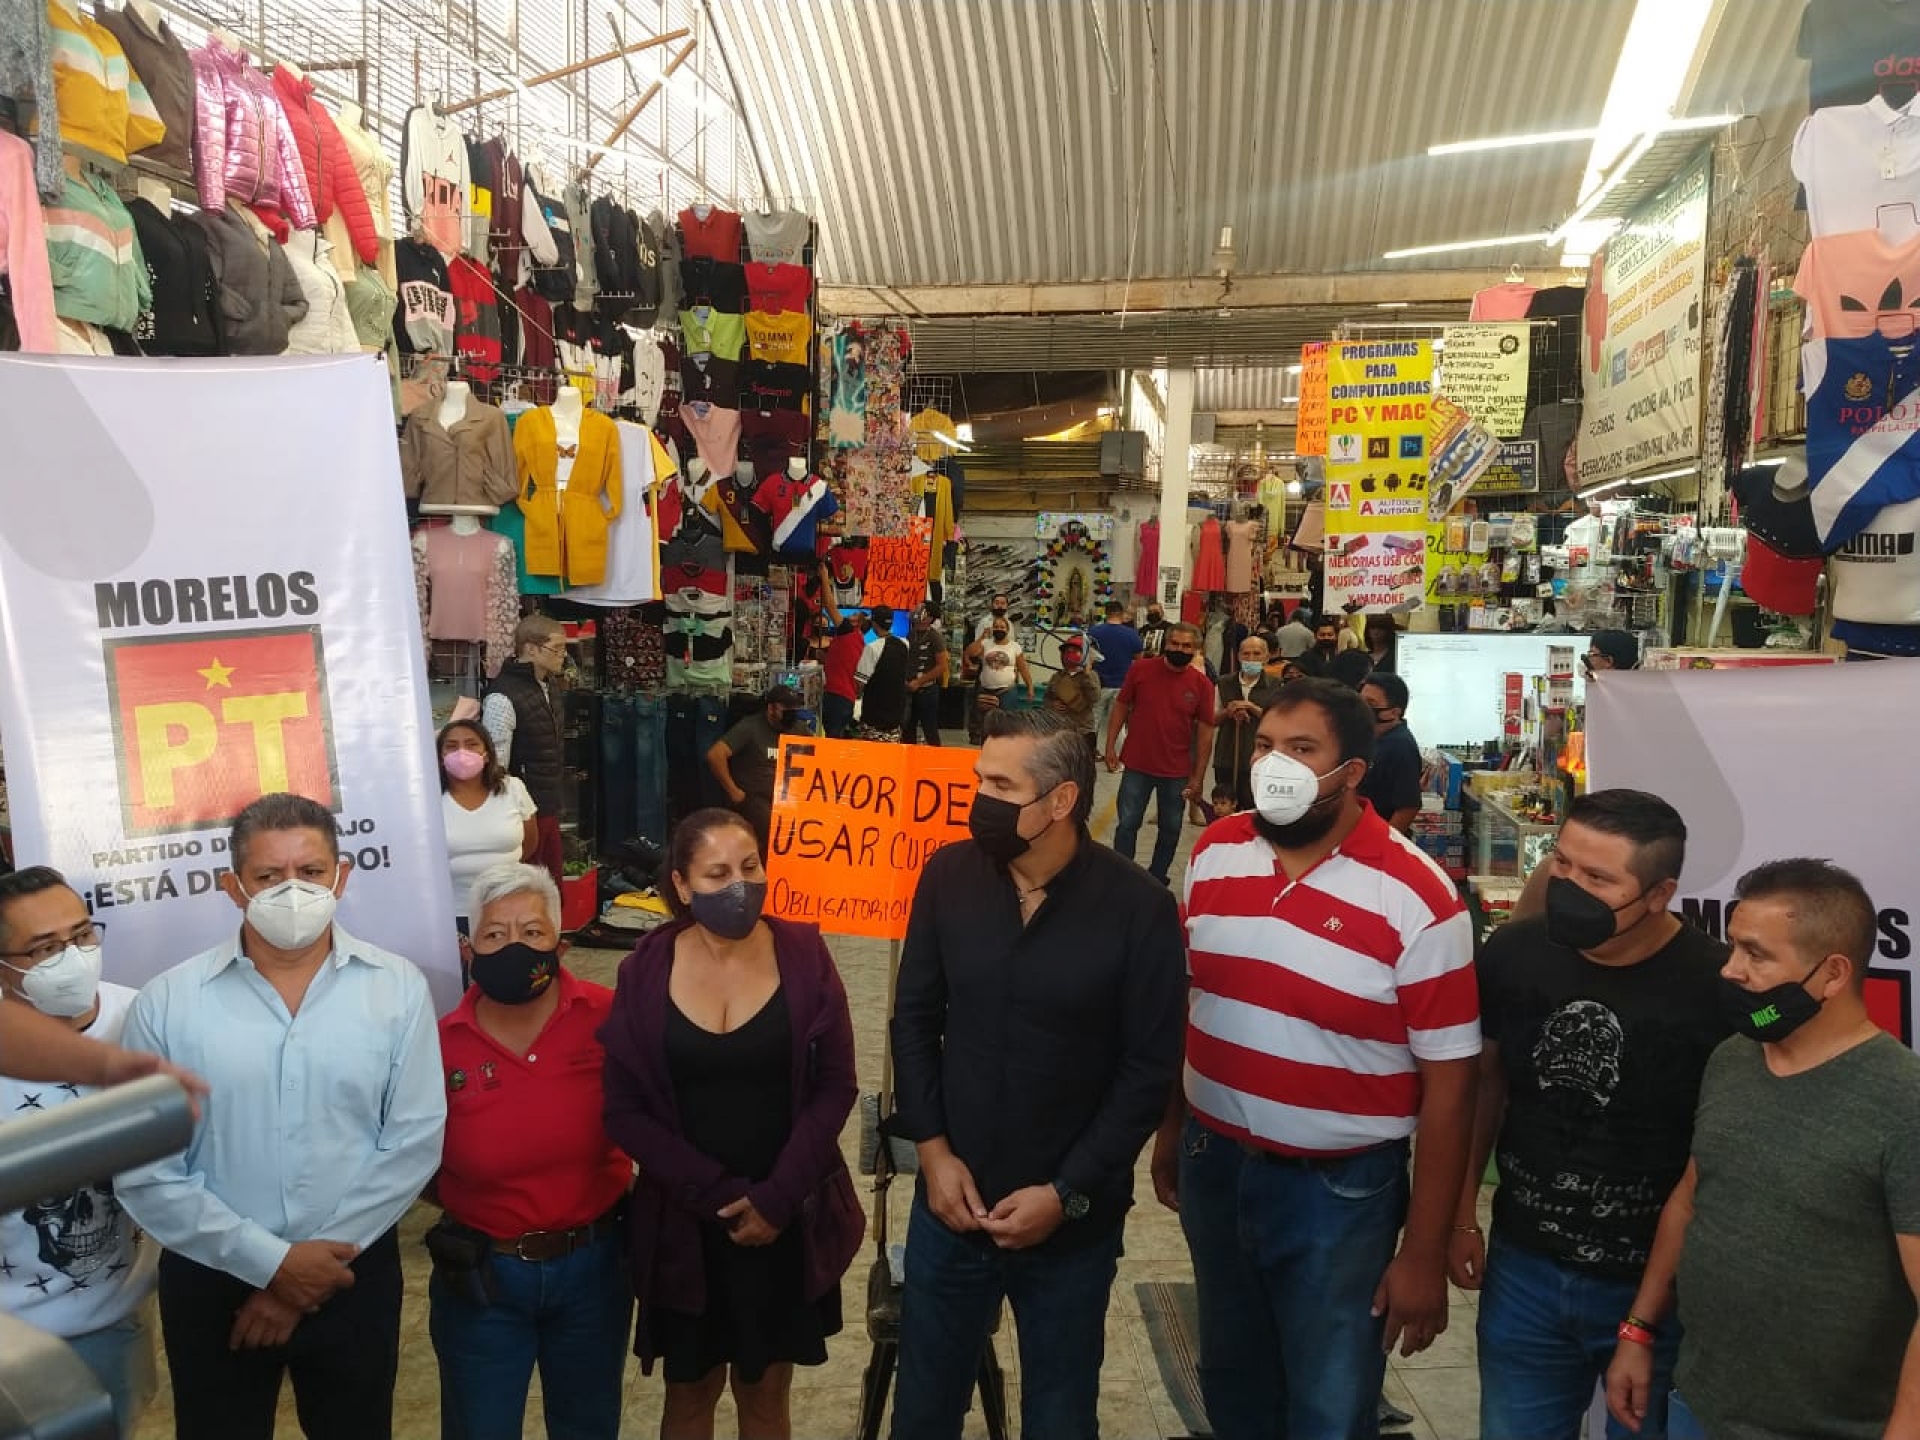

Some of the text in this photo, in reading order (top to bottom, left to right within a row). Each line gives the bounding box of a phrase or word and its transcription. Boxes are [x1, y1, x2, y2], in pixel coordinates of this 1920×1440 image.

[754, 331, 793, 342] TOMMY
[1341, 342, 1418, 360] PROGRAMAS
[1365, 363, 1397, 378] PARA
[1331, 381, 1430, 399] COMPUTADORAS
[1331, 403, 1426, 424] PC Y MAC
[1839, 405, 1907, 425] POLO
[1329, 554, 1424, 568] MEMORIAS USB CON
[94, 571, 319, 628] MORELOS
[1357, 593, 1405, 604] KARAOKE
[134, 691, 309, 809] PT
[781, 743, 970, 827] FAVOR DE
[773, 815, 880, 867] USAR
[92, 837, 202, 869] PARTIDO
[83, 868, 179, 916] ¡ESTÁ
[773, 878, 907, 922] OBLIGATORIO!
[1751, 1004, 1781, 1028] NIKE
